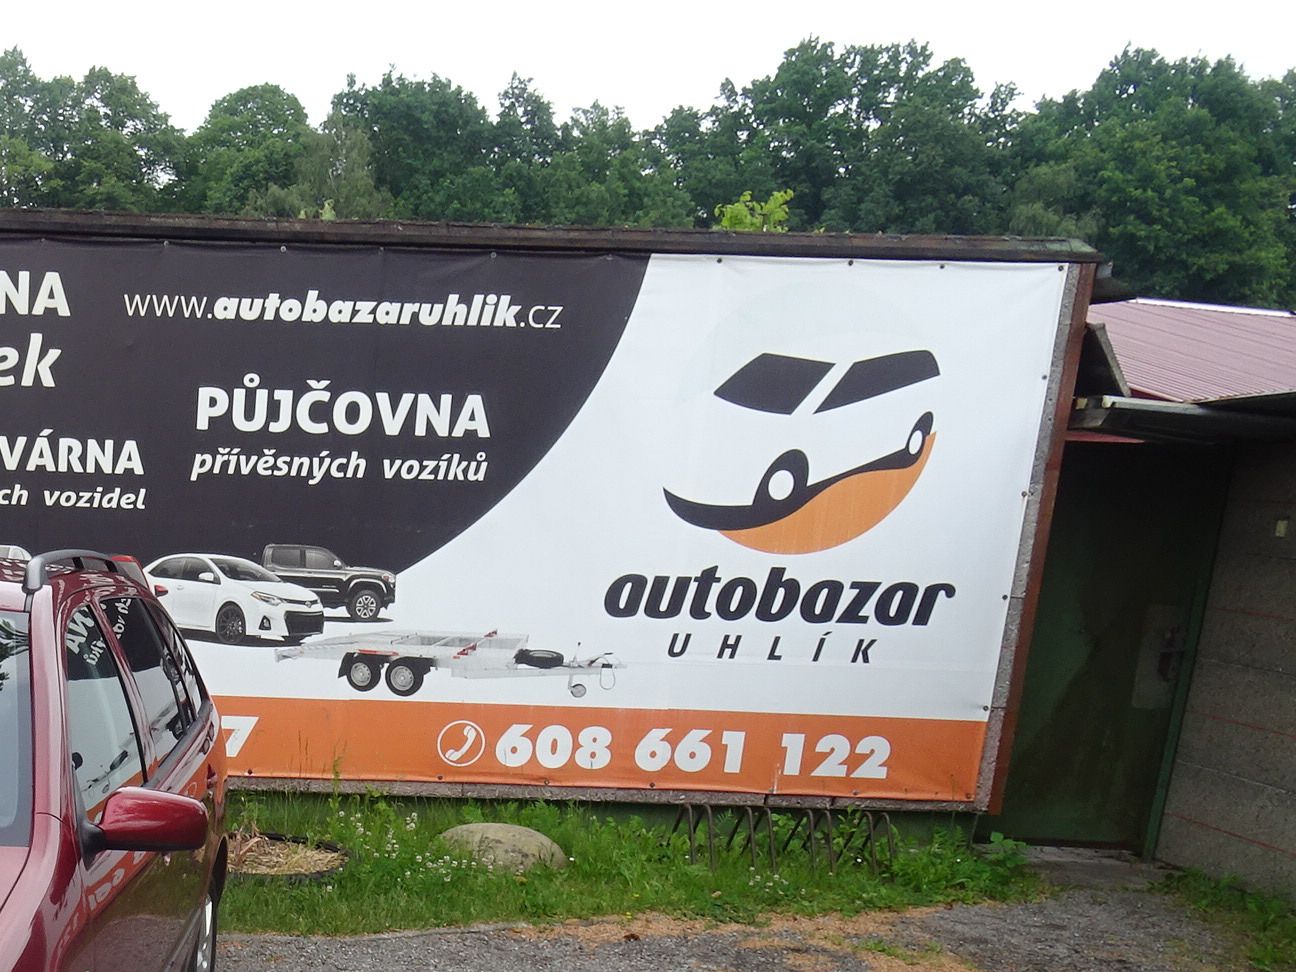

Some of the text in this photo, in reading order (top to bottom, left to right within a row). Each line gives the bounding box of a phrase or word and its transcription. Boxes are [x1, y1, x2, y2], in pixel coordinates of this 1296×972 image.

[123, 289, 564, 329] www.autobazaruhlik.cz
[196, 372, 491, 438] PŮJČOVNA
[189, 447, 489, 485] přívěsných vozíků
[43, 486, 147, 510] vozidel
[604, 565, 956, 627] autobazar
[495, 723, 891, 779] 608 661 122
